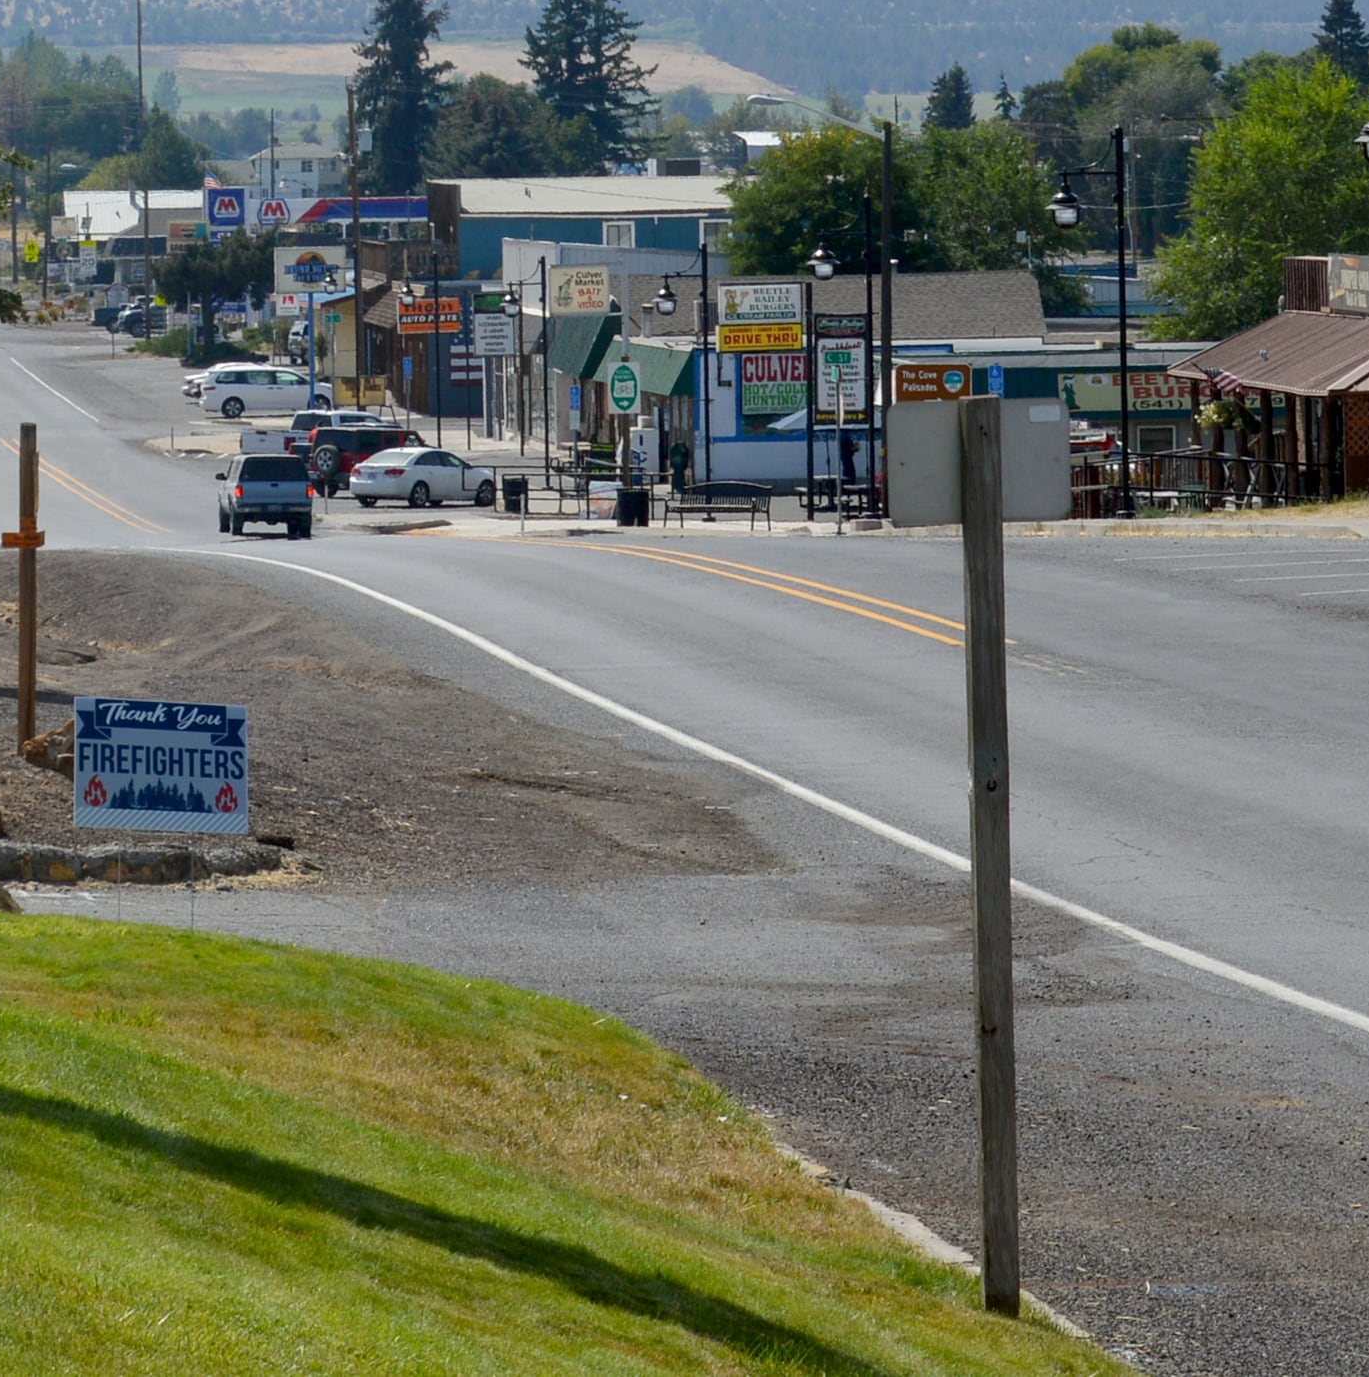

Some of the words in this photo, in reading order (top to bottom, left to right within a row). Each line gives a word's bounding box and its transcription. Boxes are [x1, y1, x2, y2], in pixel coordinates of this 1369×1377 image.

[575, 271, 603, 279] Culver
[574, 278, 605, 287] Market
[578, 288, 602, 297] BAIT
[752, 287, 791, 295] BEETLE
[754, 295, 791, 303] BAILEY
[577, 301, 604, 309] VIDEO
[400, 314, 427, 324] AUTO
[427, 314, 458, 323] PRTS
[723, 334, 762, 345] DRIVE
[765, 333, 799, 344] THRU
[902, 370, 916, 380] The
[918, 370, 938, 380] Cove
[902, 382, 938, 392] Palisades
[1132, 398, 1184, 411] (541)
[98, 700, 167, 725] Thank
[172, 705, 223, 730] You
[78, 742, 245, 780] FIREFIGHTERS
